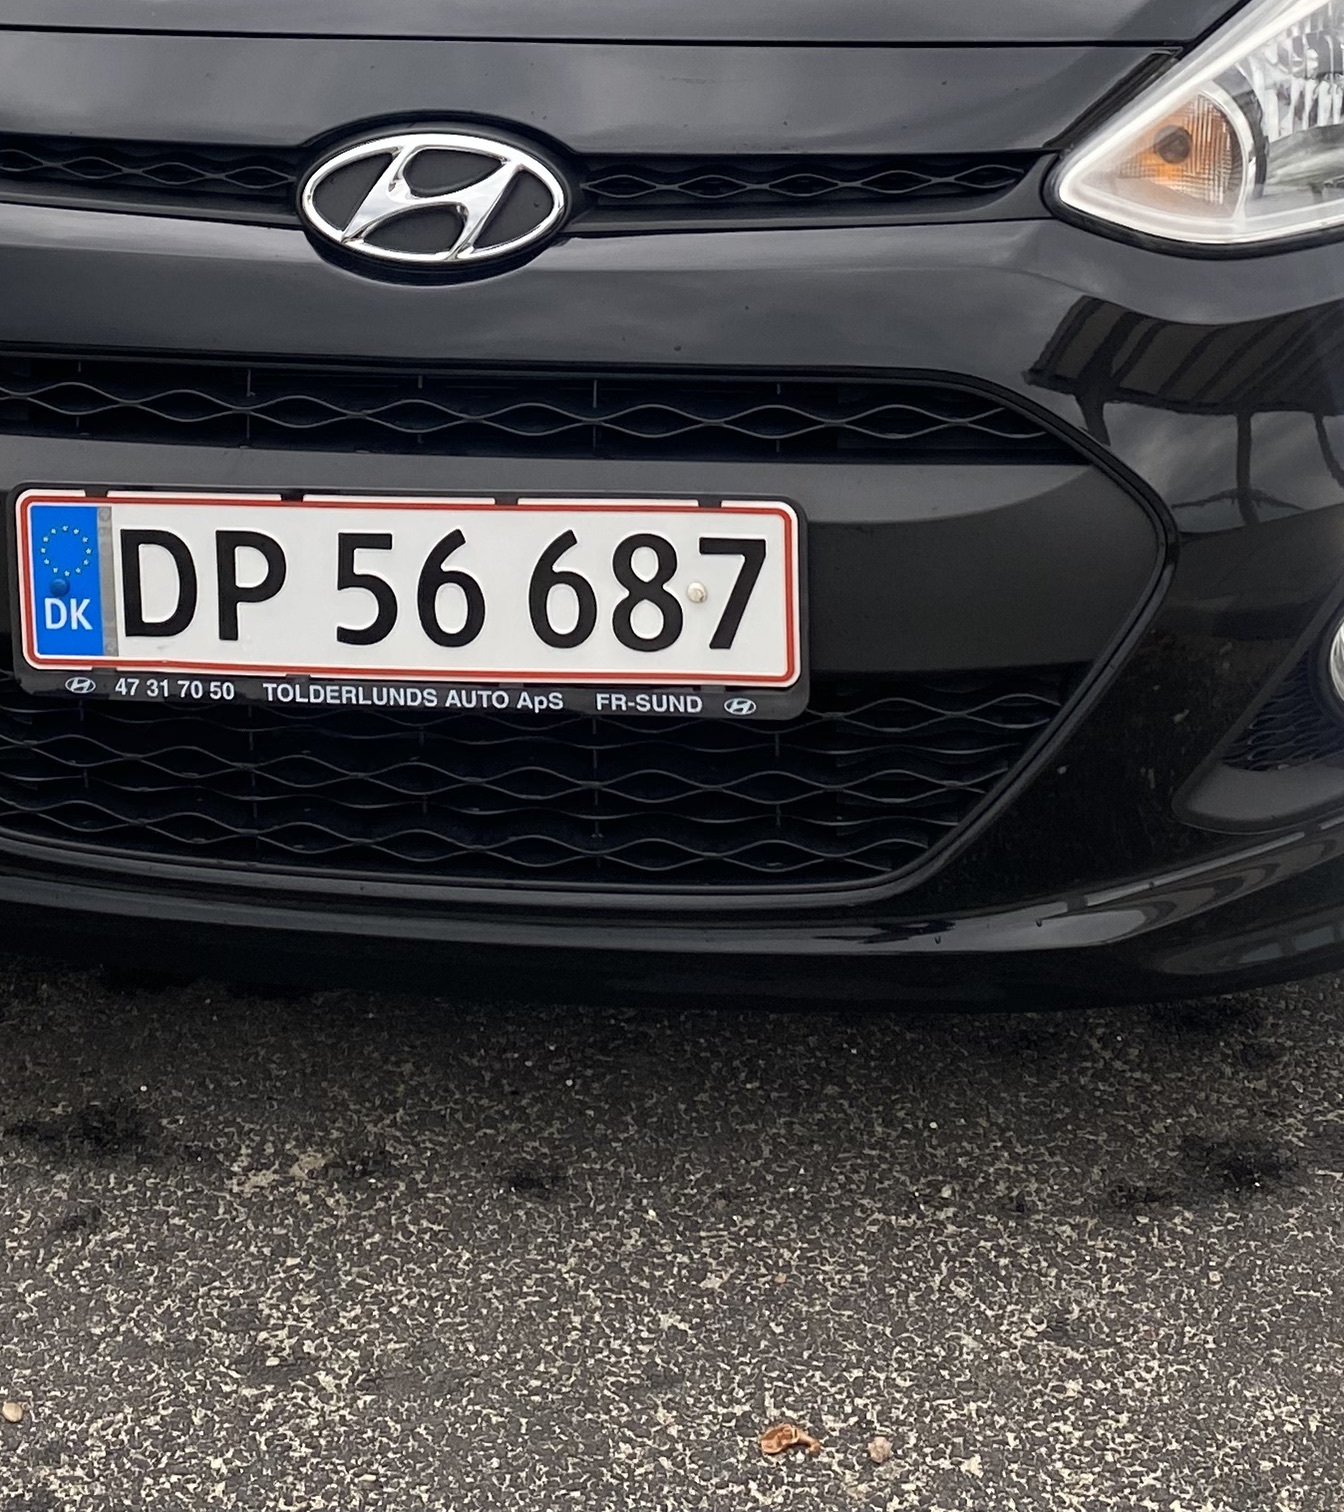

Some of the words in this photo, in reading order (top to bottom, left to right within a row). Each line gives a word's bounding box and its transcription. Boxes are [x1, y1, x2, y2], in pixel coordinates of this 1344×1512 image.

[120, 528, 287, 641] DP
[336, 529, 486, 649] 56
[528, 529, 767, 652] 687
[44, 597, 93, 630] DK
[115, 678, 140, 696] 47
[146, 679, 169, 697] 31
[177, 680, 203, 699] 70
[209, 682, 235, 700] 50
[262, 683, 438, 707] TOLDERLUNDS
[444, 689, 510, 709] AUTO
[516, 691, 564, 713] ApS
[596, 693, 703, 713] FR-SUND
